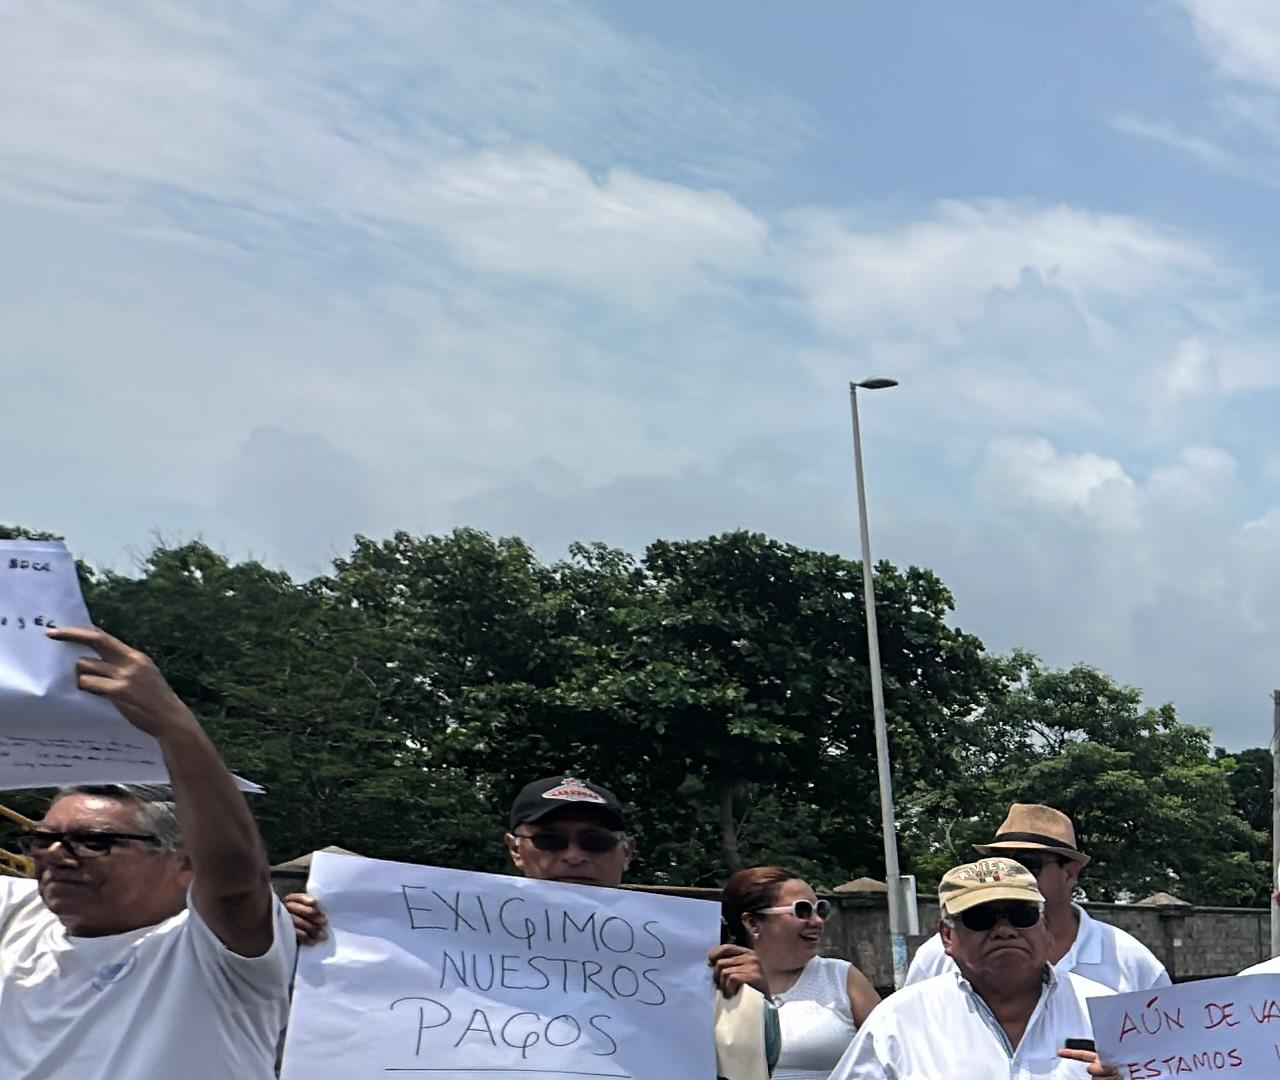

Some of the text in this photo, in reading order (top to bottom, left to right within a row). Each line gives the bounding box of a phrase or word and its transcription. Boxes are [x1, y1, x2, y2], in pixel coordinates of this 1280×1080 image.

[402, 885, 666, 959] EXIGIMOS
[440, 950, 665, 1005] NUESTROS
[390, 997, 617, 1059] PAGOS
[1119, 996, 1184, 1043] AÚN
[1204, 1003, 1240, 1029] DE
